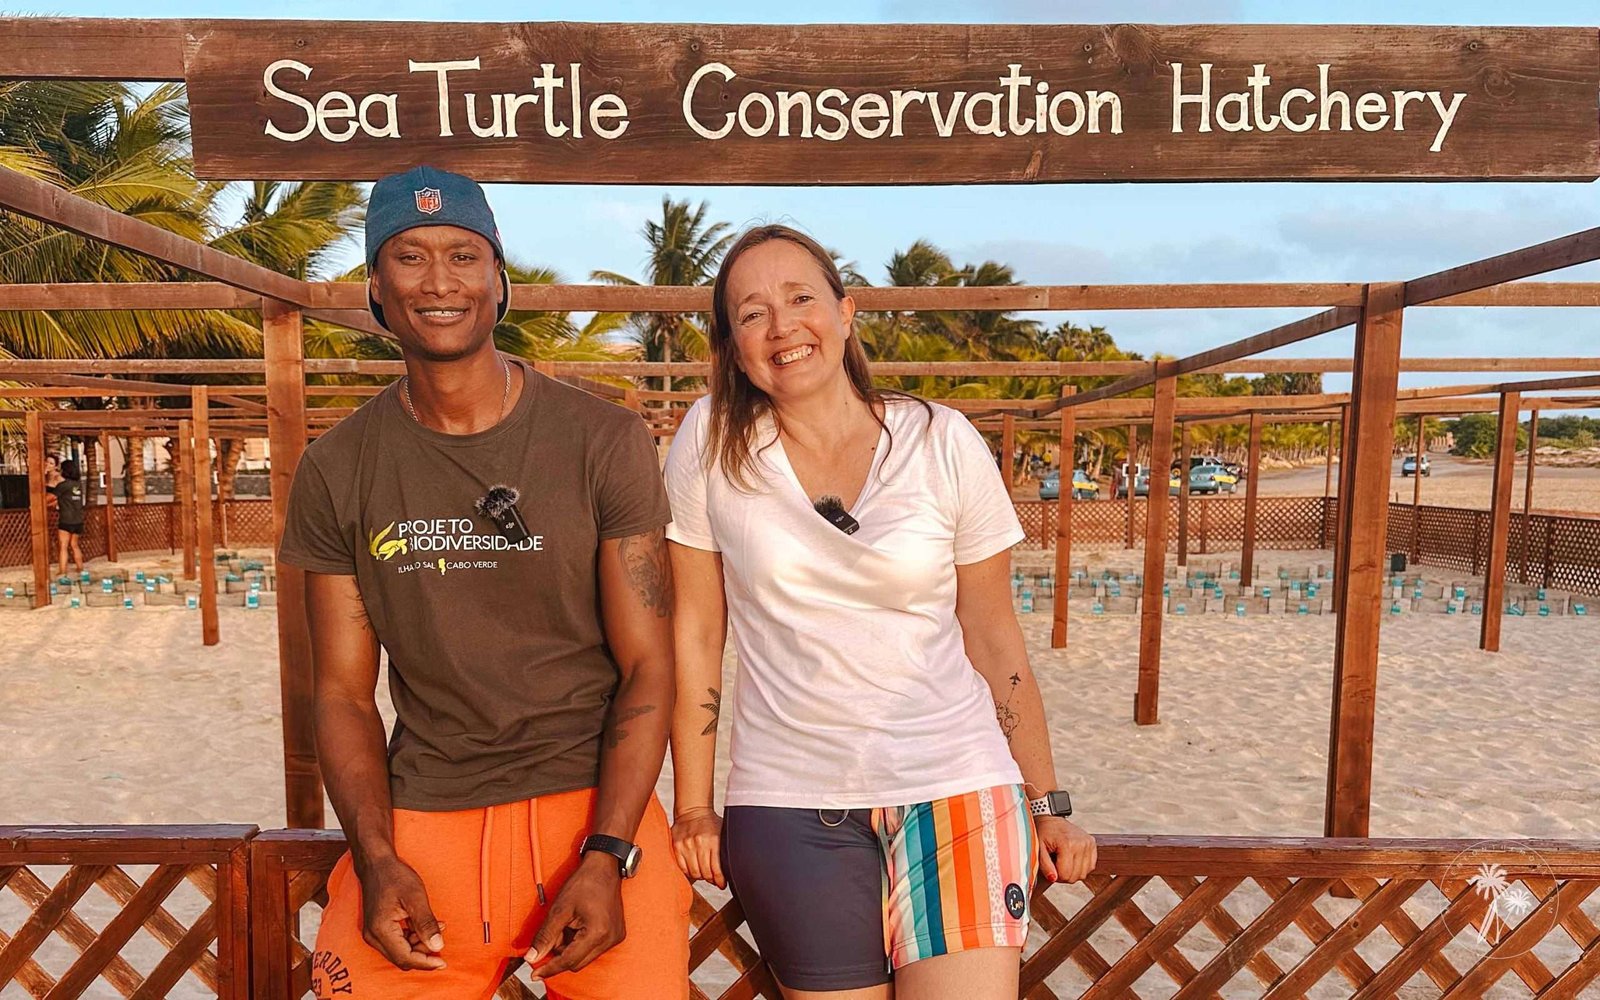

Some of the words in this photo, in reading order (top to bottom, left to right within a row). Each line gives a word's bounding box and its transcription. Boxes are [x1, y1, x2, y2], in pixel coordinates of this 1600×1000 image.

[262, 59, 402, 142] Sea
[408, 56, 630, 140] Turtle
[682, 62, 1123, 140] Conservation
[1171, 62, 1467, 152] Hatchery
[398, 519, 473, 538] PROJETO
[398, 564, 414, 574] ILHA
[422, 561, 436, 570] SAL
[446, 561, 472, 570] CABO
[472, 561, 498, 569] VERDE
